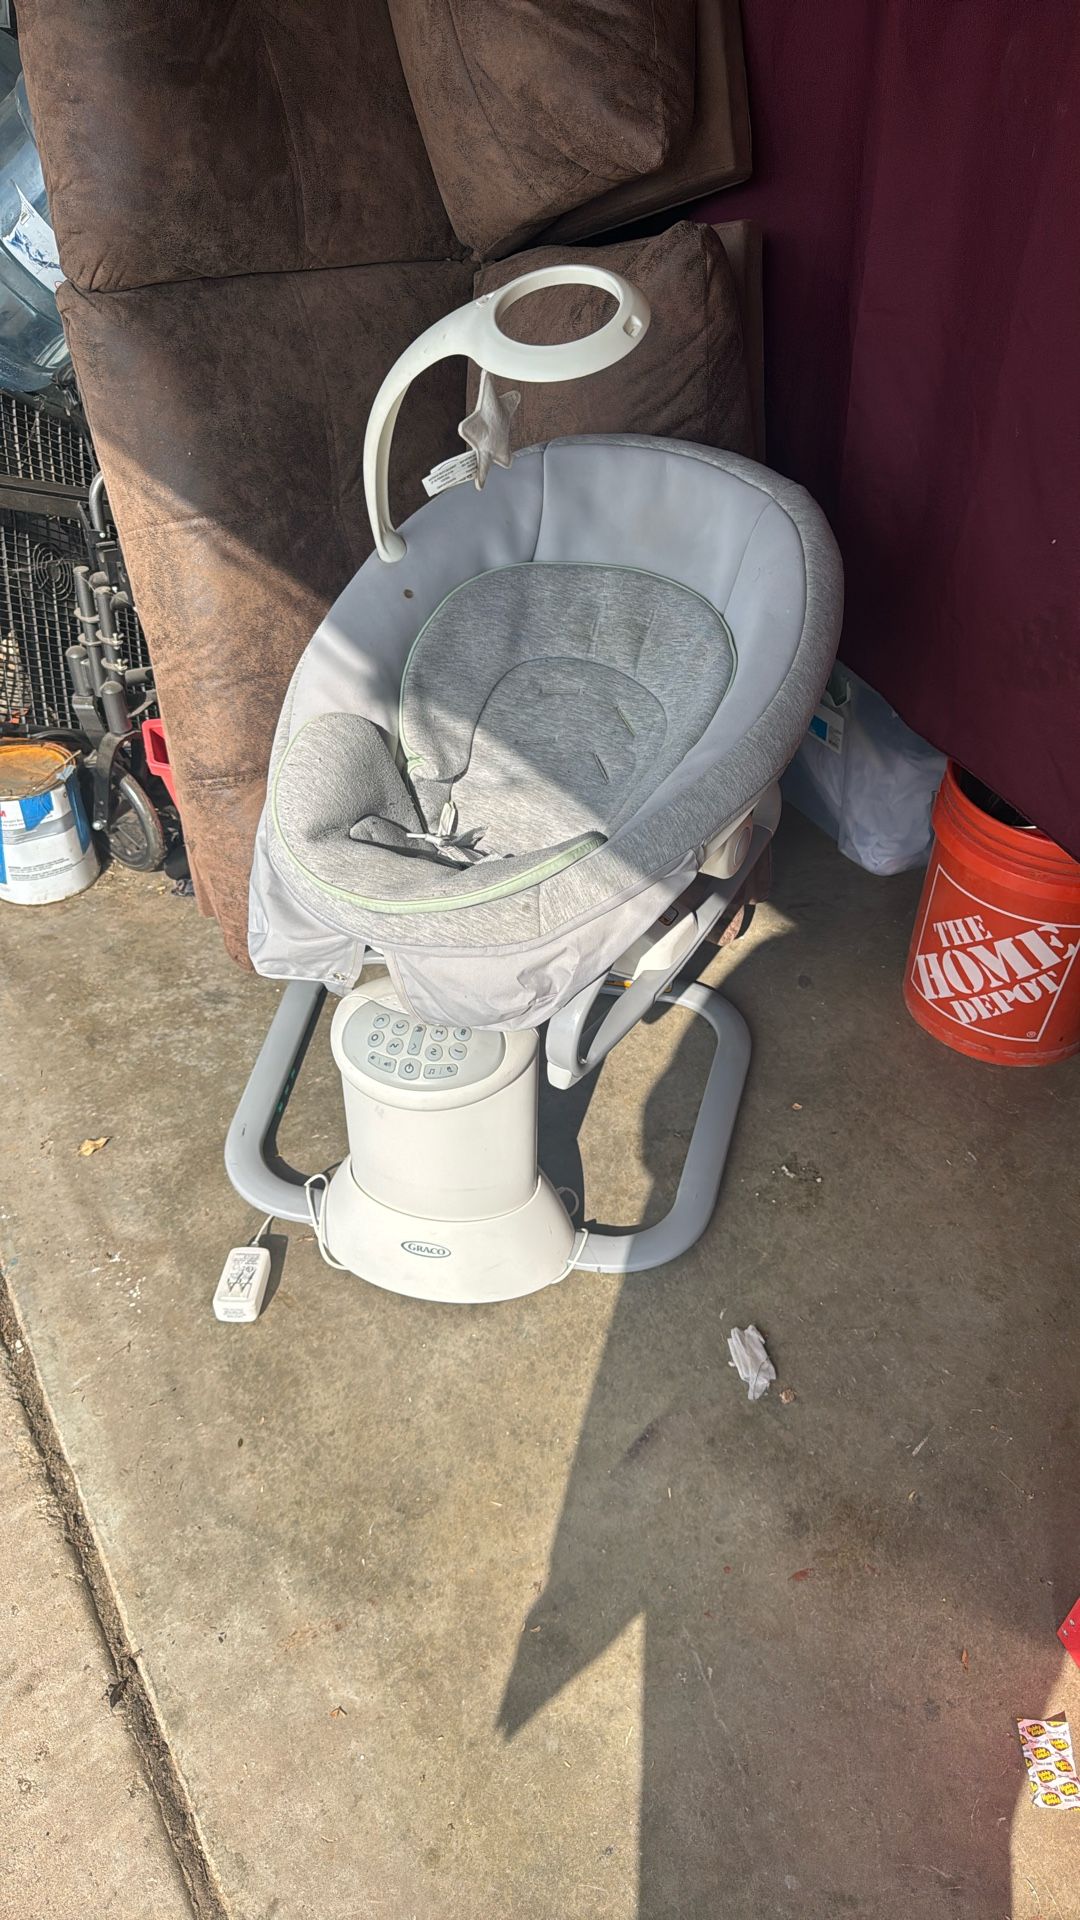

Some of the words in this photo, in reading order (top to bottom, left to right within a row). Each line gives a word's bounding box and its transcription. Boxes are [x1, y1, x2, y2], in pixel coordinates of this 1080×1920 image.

[933, 915, 993, 947] THE
[917, 924, 1076, 1000] HOME
[950, 971, 1060, 1024] DEPOT
[408, 1243, 446, 1256] GRACO
